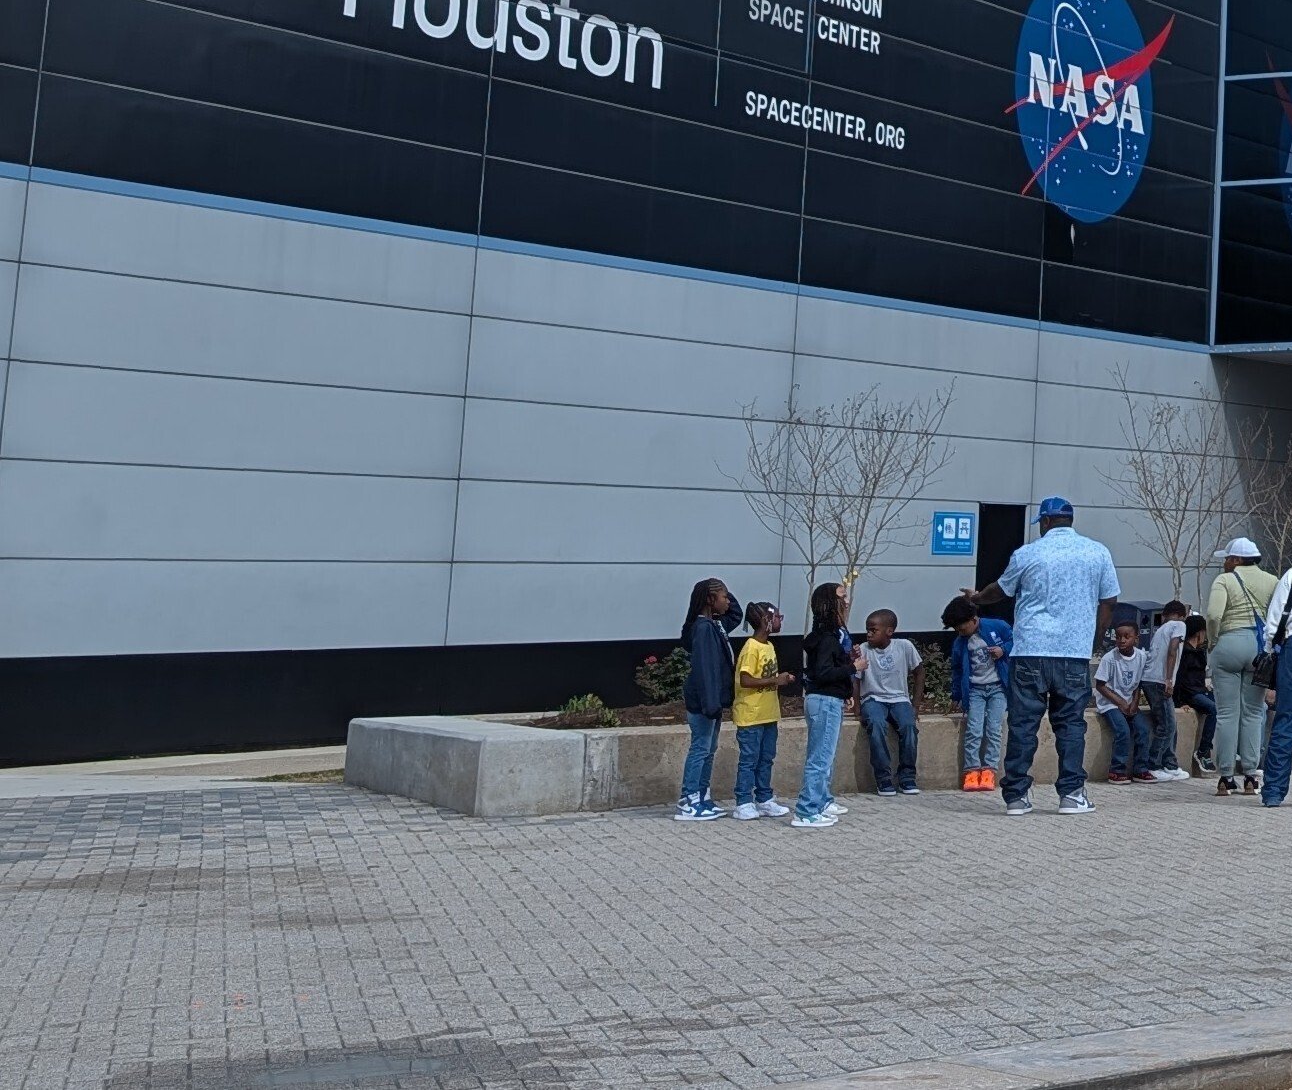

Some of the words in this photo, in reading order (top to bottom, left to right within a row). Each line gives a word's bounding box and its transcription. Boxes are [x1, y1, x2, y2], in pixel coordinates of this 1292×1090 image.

[817, 16, 881, 55] CENTER
[745, 90, 905, 150] SPACECENTER.ORG
[1027, 51, 1146, 136] NASA
